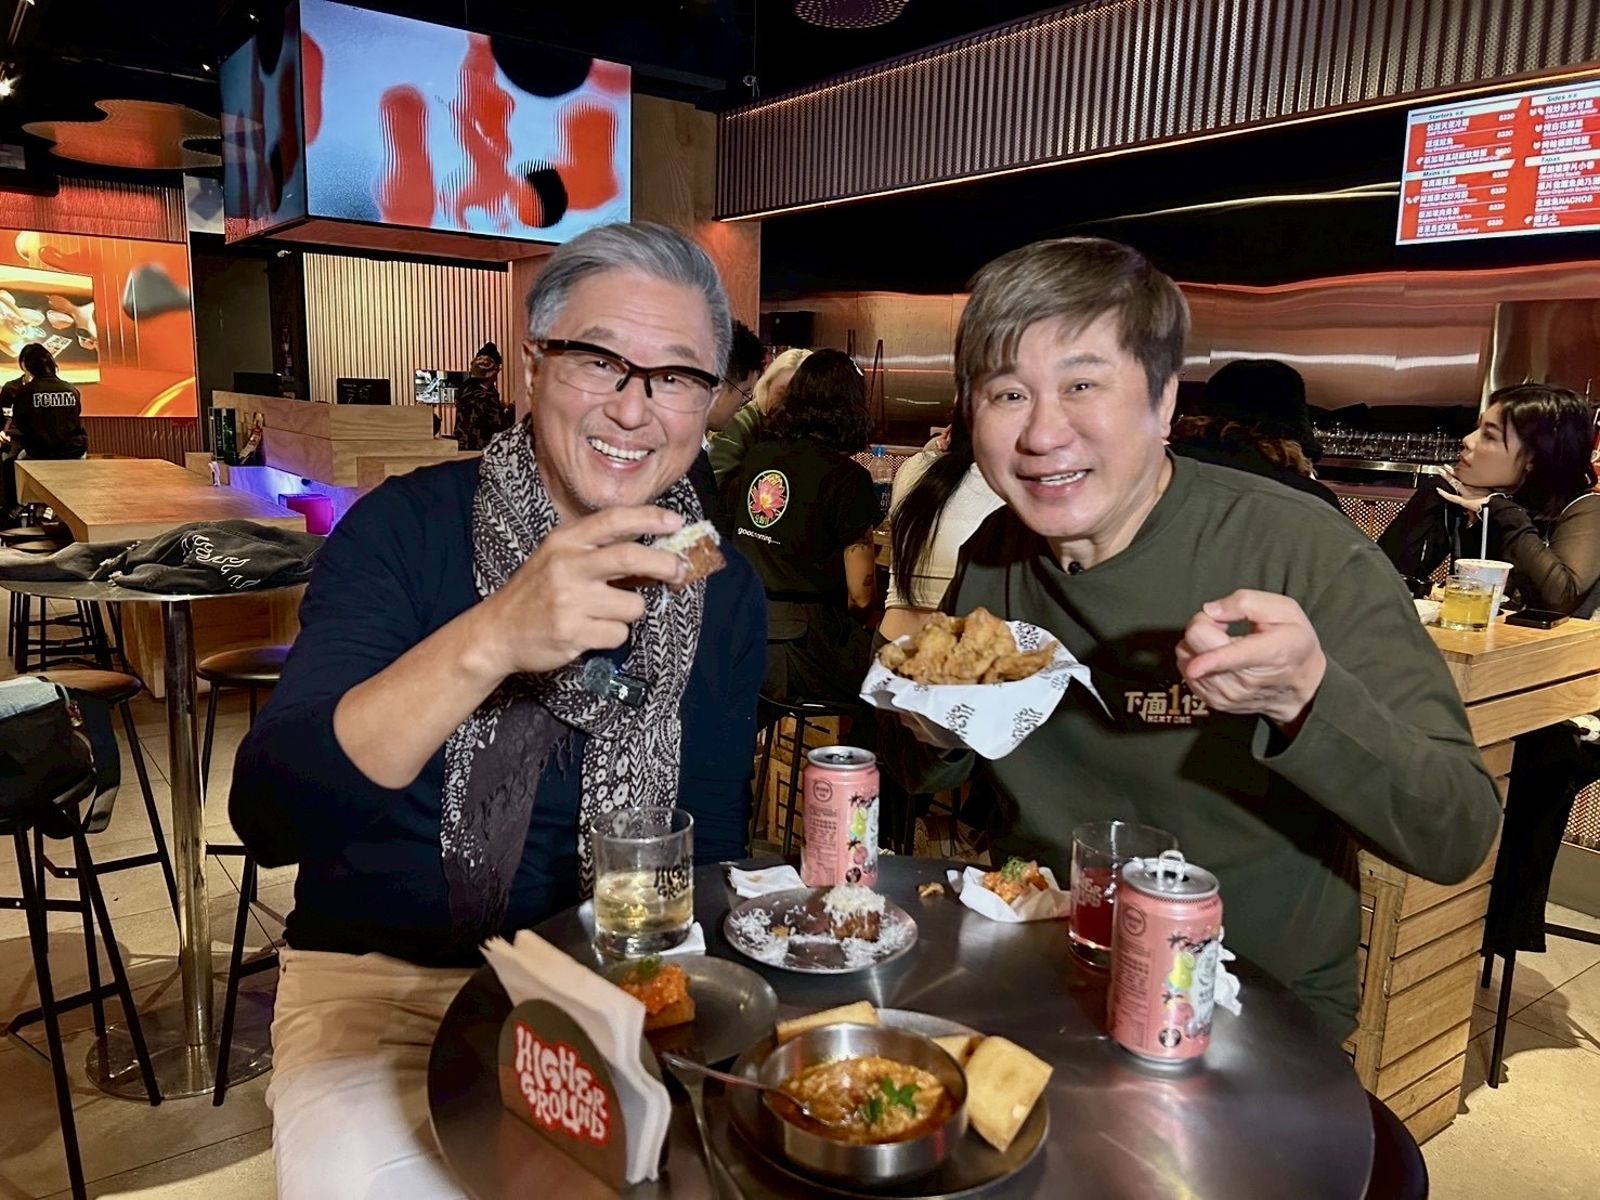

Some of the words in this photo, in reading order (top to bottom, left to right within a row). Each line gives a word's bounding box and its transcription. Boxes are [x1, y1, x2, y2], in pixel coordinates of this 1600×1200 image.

[1428, 112, 1453, 120] Starters
[33, 391, 76, 408] FCMM
[1124, 684, 1209, 721] 下面1位
[1147, 715, 1173, 723] NEXT
[1173, 716, 1192, 724] ONE
[515, 1024, 608, 1120] HIGHER
[520, 1071, 606, 1140] GROUND
